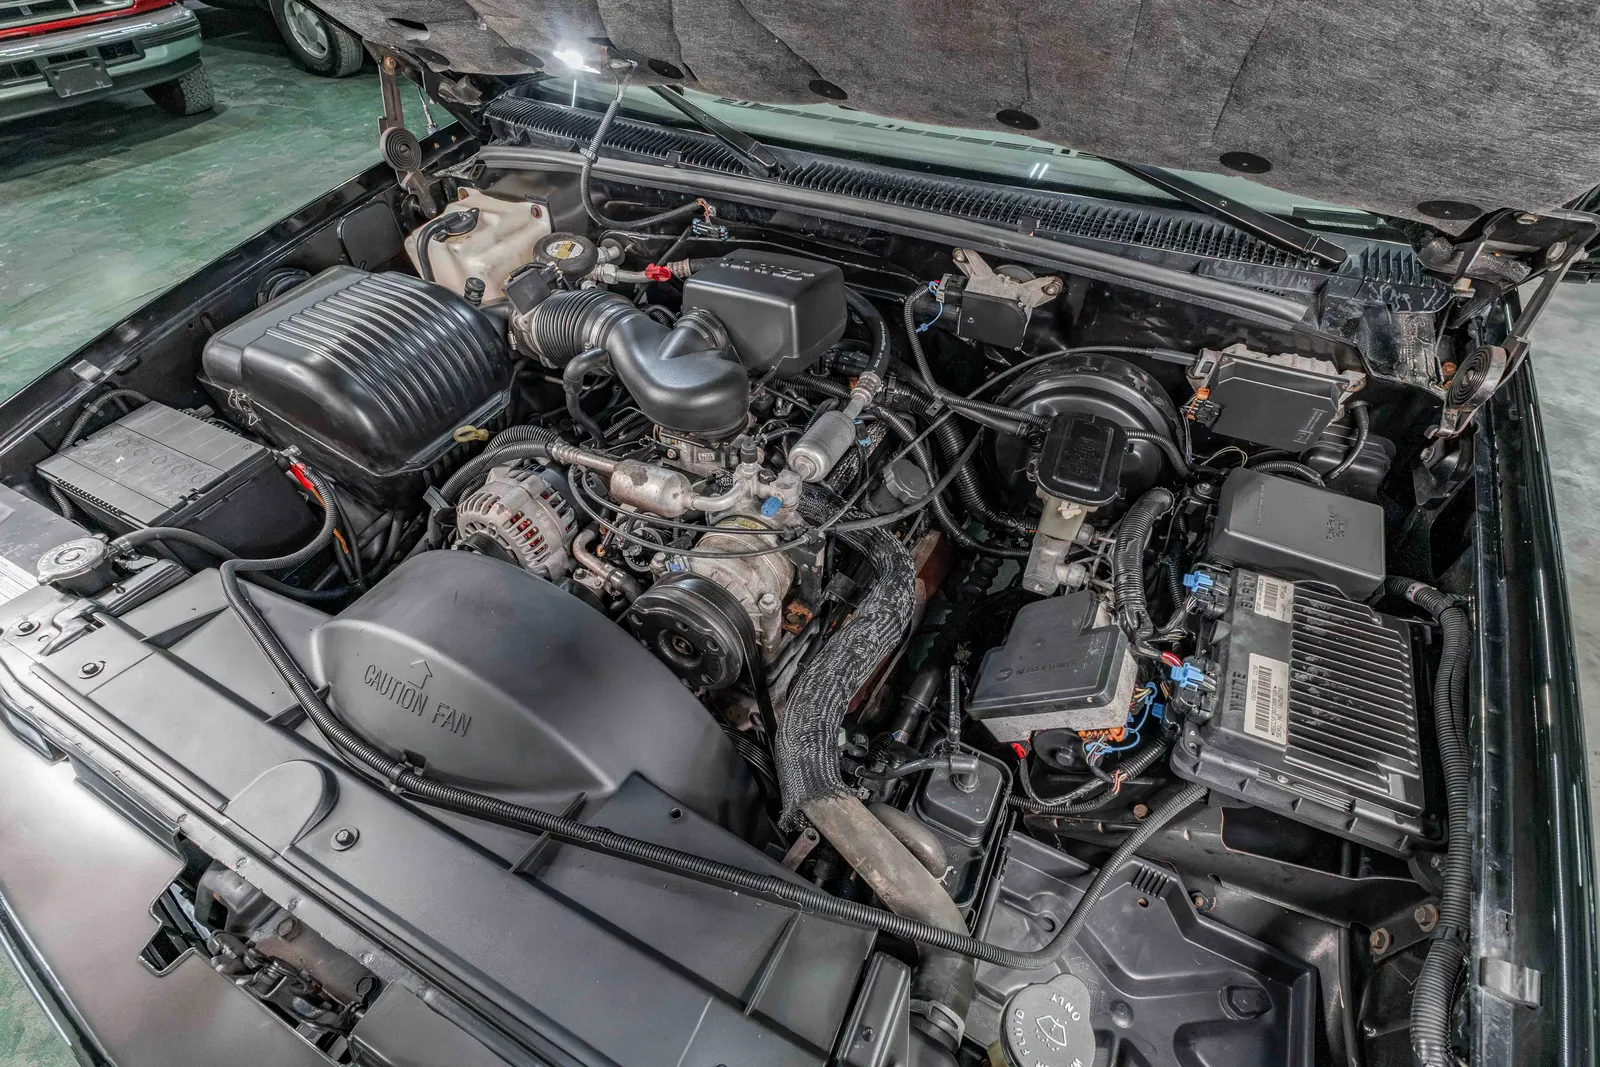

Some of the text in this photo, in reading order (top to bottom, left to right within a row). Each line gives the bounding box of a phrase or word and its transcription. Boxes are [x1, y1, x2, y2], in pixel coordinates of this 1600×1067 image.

[364, 664, 472, 737] CAUTION FAN
[1229, 671, 1246, 711] WHITE
[1050, 992, 1081, 1021] ONLY
[1014, 1008, 1030, 1056] FLUID
